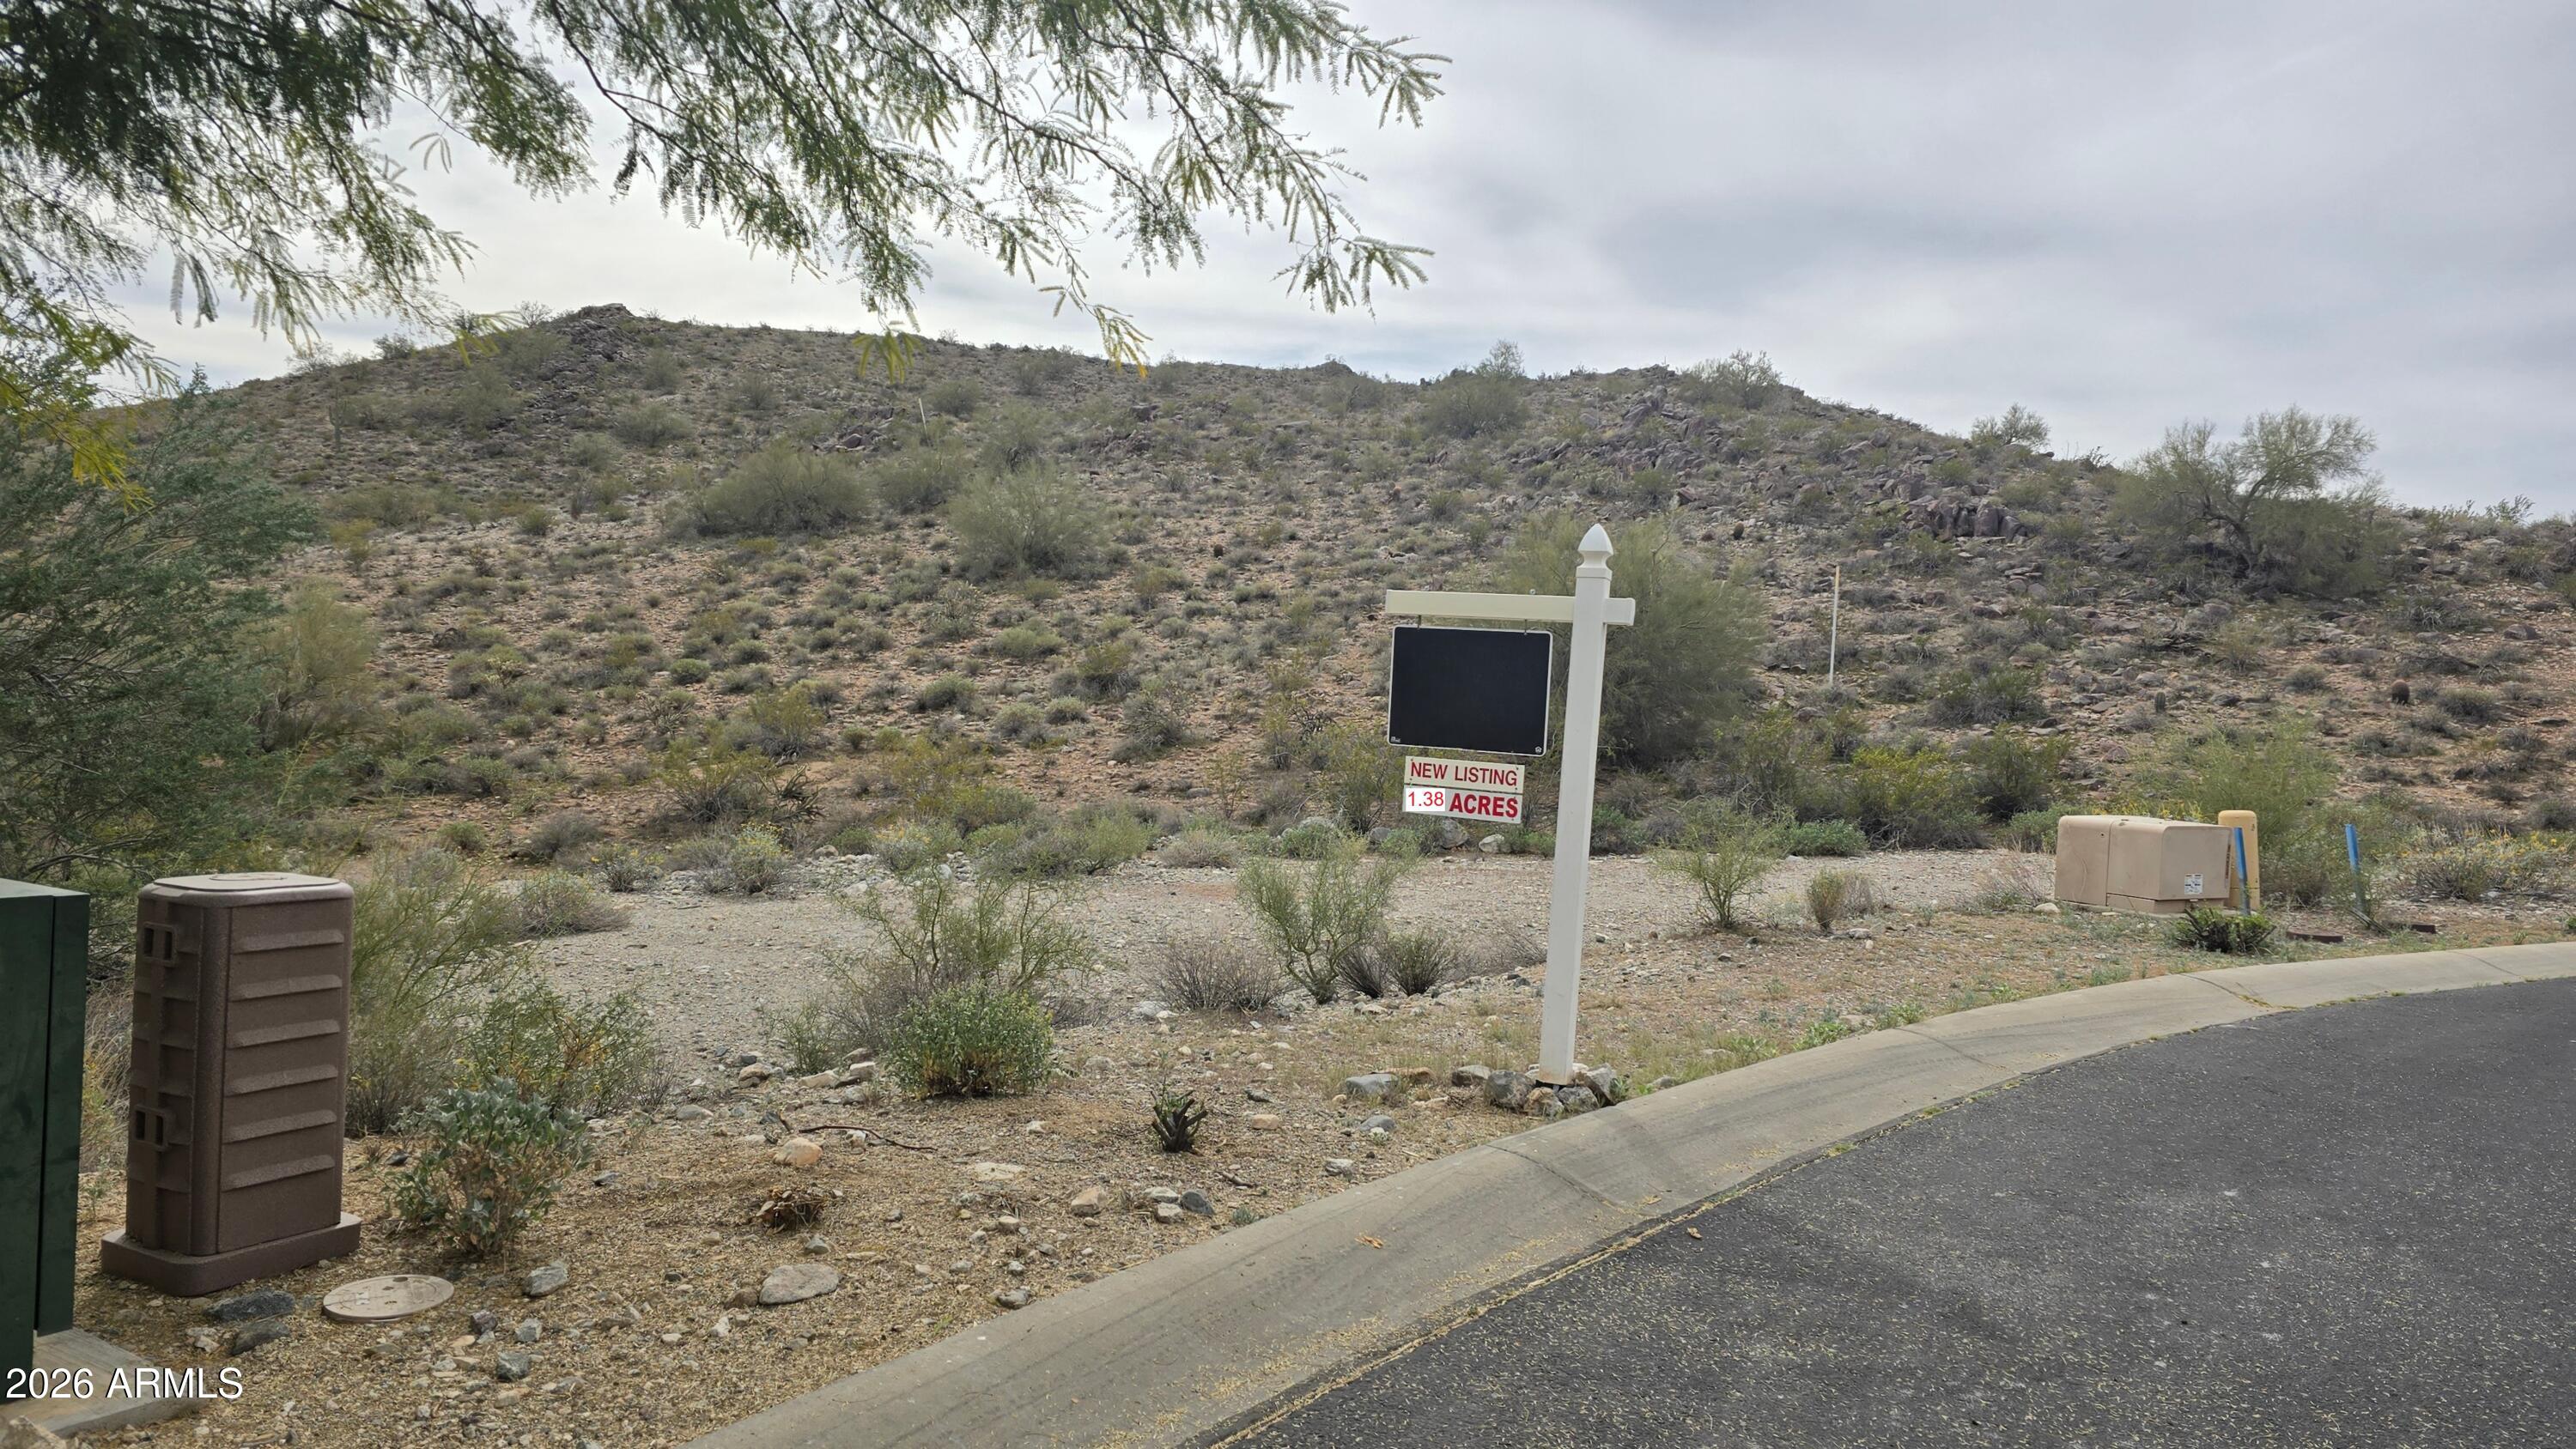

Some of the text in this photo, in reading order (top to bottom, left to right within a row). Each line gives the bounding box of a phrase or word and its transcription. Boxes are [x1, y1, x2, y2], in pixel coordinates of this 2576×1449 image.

[1411, 761, 1517, 786] NEW LISTING
[1408, 791, 1518, 818] 1.38 ACRES
